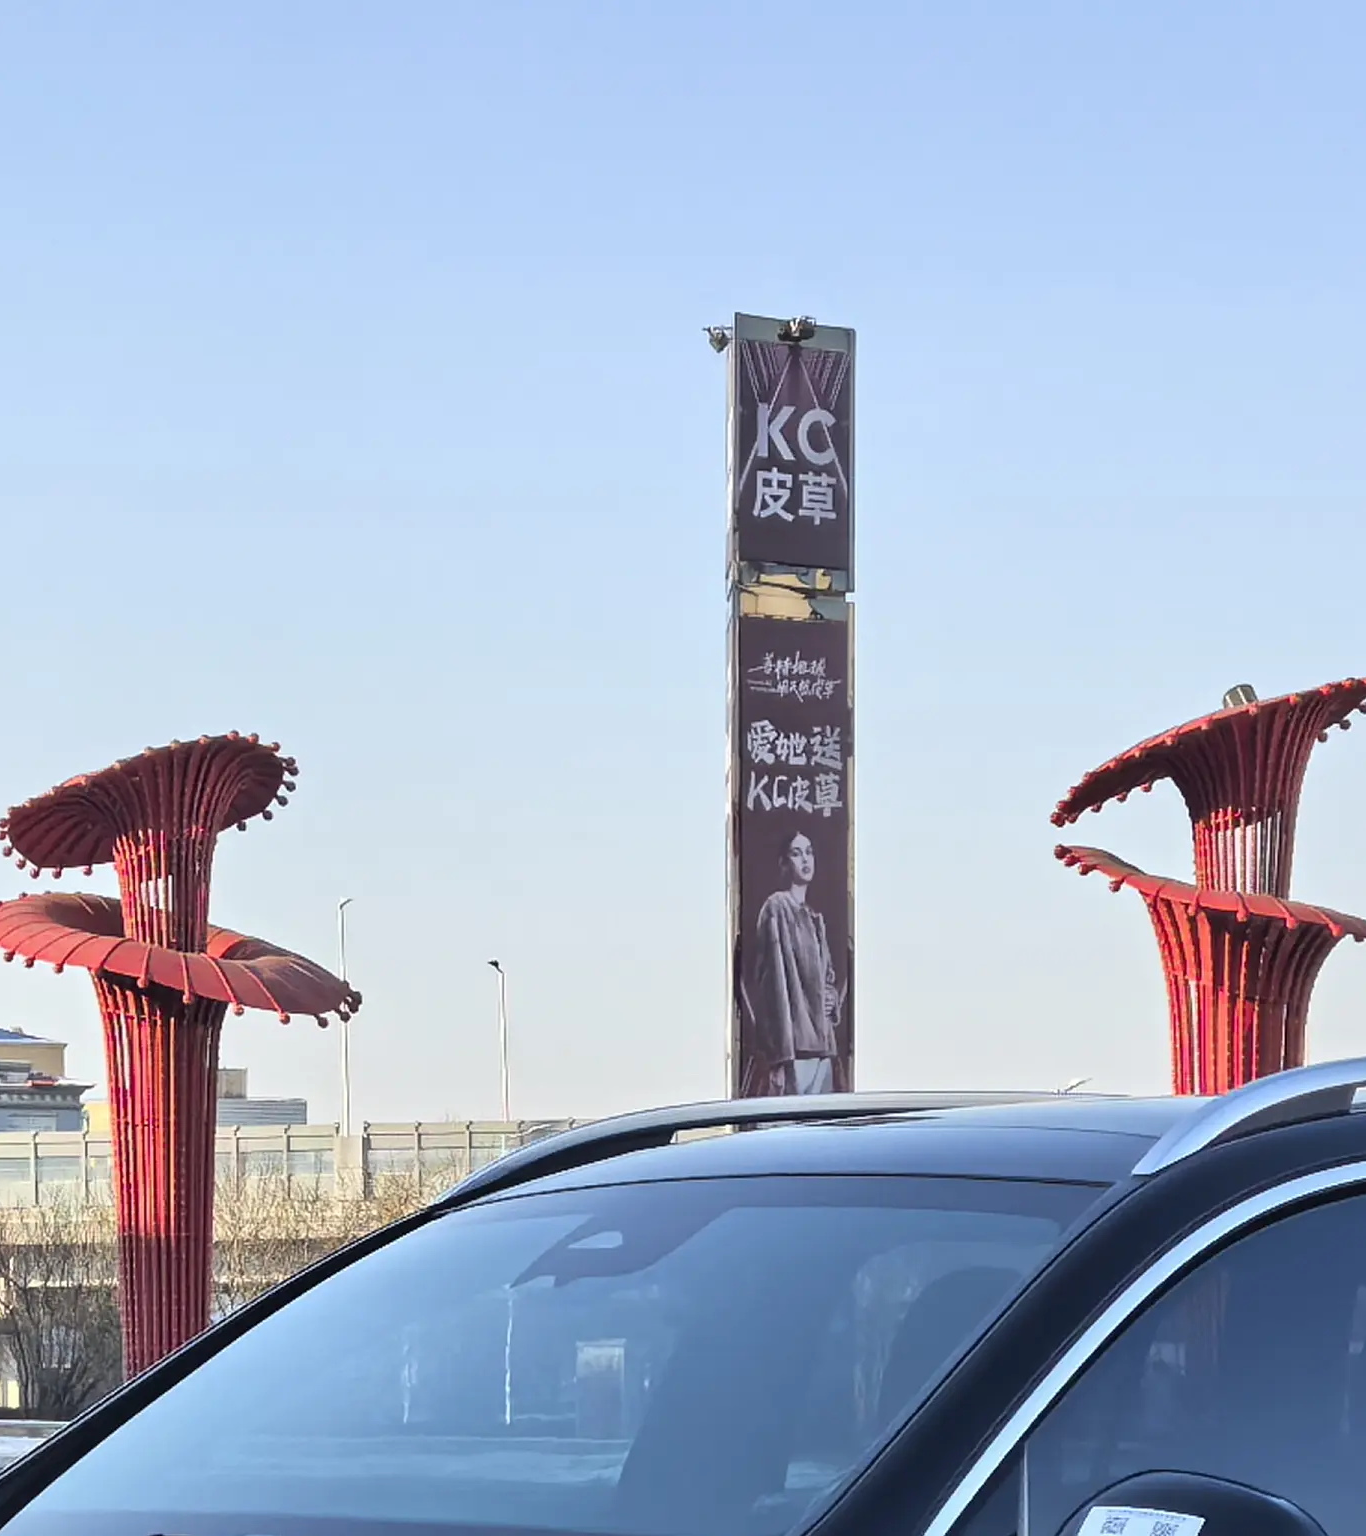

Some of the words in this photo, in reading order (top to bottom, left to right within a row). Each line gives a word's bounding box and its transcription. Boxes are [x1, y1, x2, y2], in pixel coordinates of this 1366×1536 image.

[756, 402, 837, 466] KC
[753, 467, 838, 526] 皮草
[746, 771, 844, 818] KC皮草
